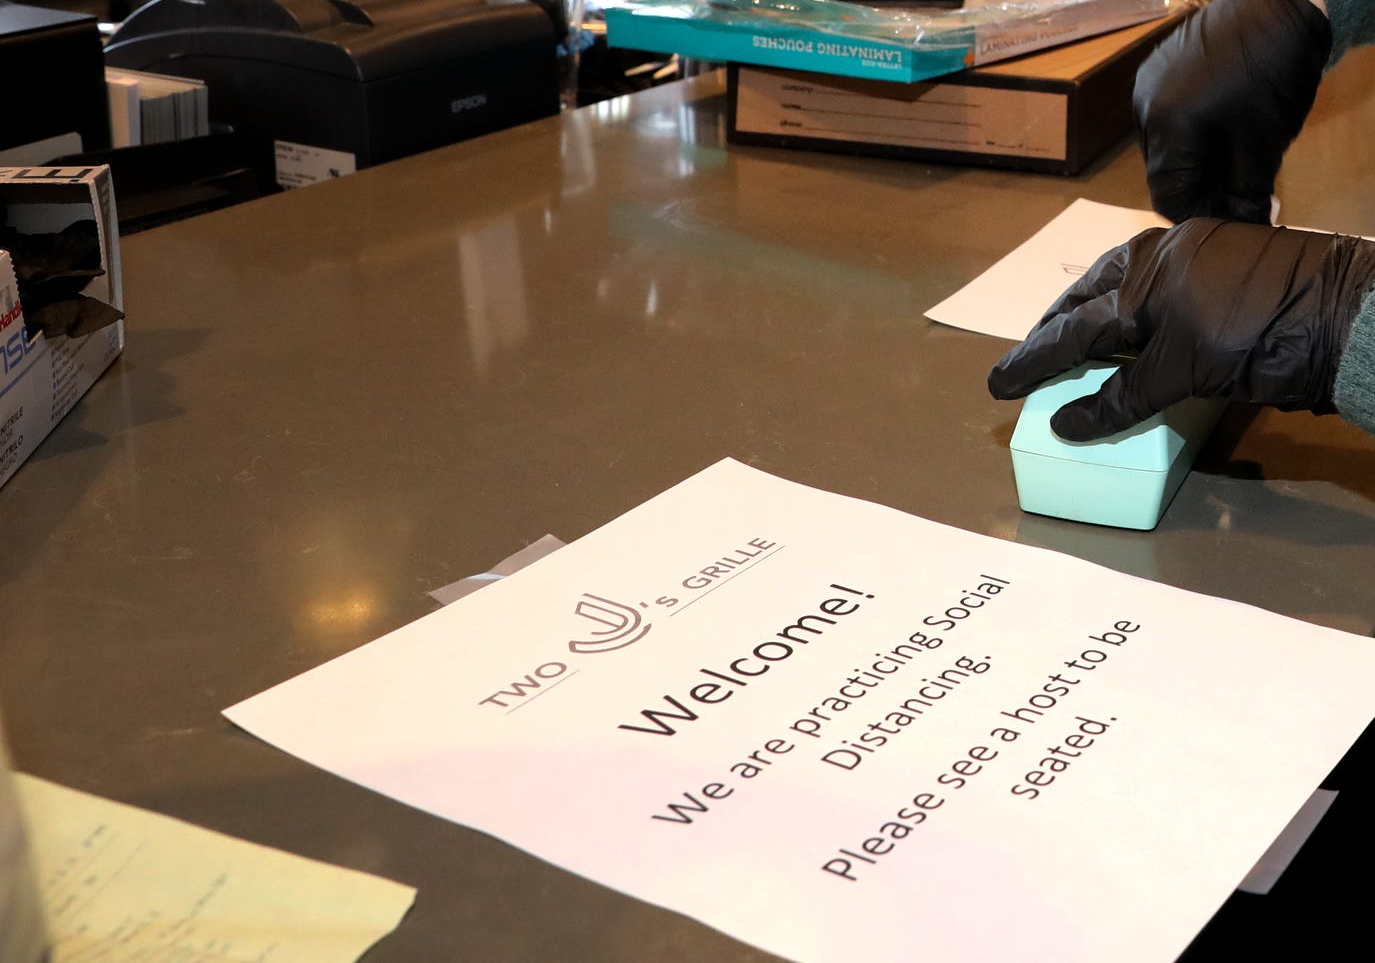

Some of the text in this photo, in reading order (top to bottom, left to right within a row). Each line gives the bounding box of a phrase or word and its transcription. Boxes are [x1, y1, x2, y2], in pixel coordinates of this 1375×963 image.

[451, 94, 487, 114] EPSON
[752, 35, 903, 63] LAMINATING POUCHES
[478, 662, 568, 708] TWO
[682, 538, 776, 590] GRILLE
[617, 584, 875, 737] Welcome!
[651, 574, 1011, 825] We are practicing Social
[821, 655, 992, 771] Distancing.
[821, 619, 1141, 882] Please see a host to be
[1011, 716, 1118, 800] seated.
